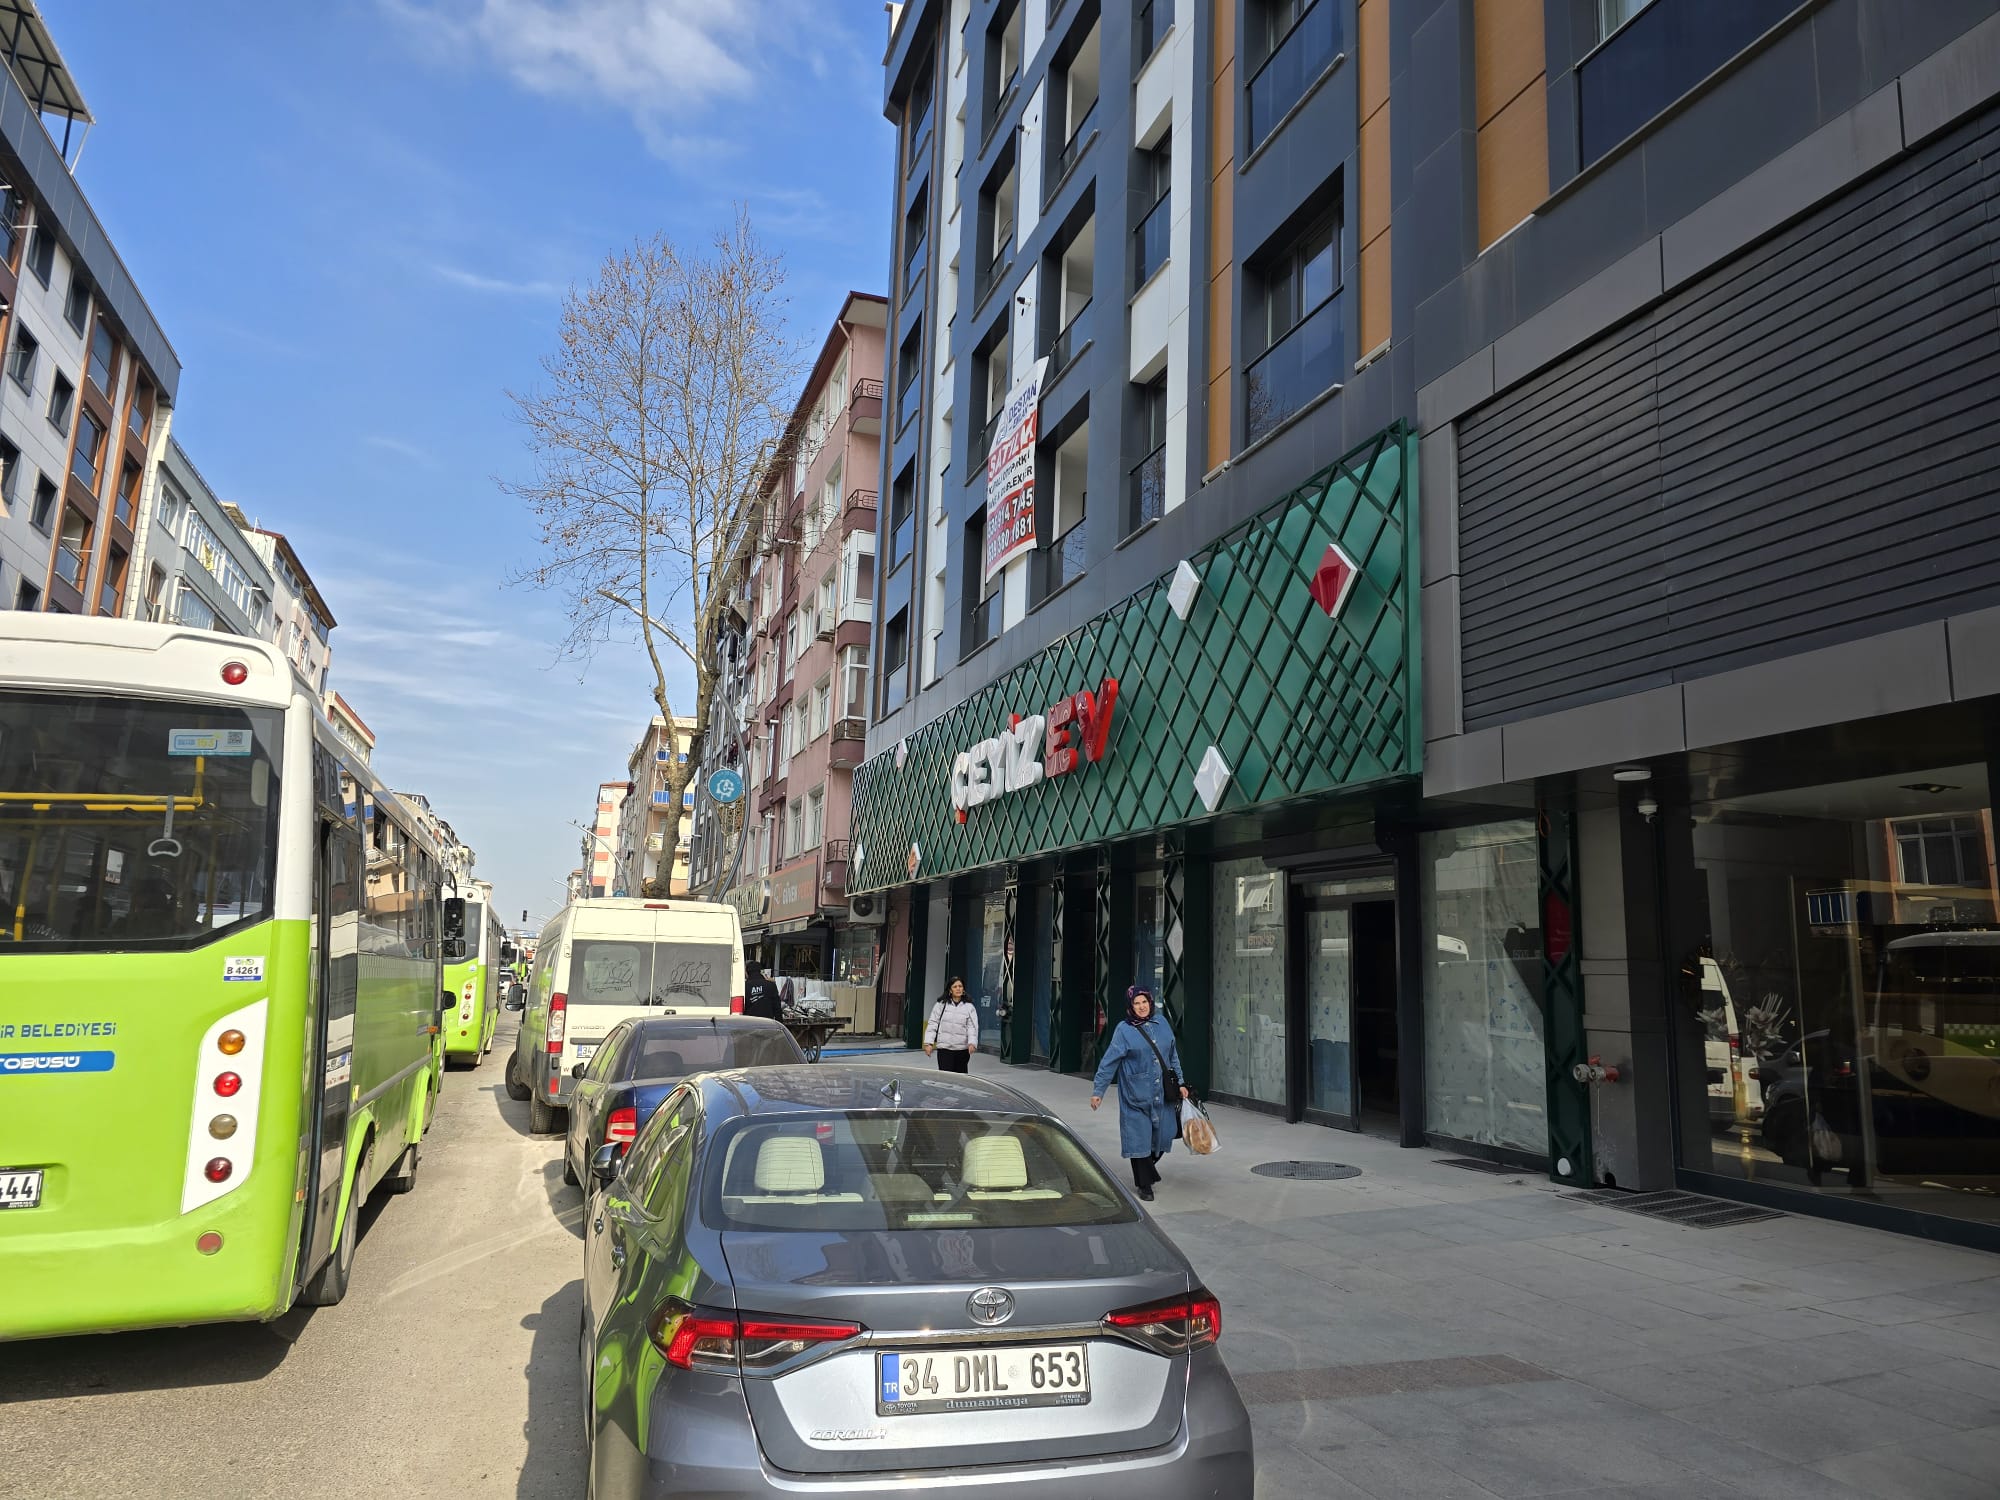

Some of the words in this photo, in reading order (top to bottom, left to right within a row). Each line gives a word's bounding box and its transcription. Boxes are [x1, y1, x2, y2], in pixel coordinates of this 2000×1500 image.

[1008, 379, 1037, 422] DESTAN
[226, 966, 234, 975] B
[235, 966, 259, 975] 4261
[0, 1176, 33, 1199] 44
[884, 1382, 898, 1394] TR
[903, 1358, 939, 1396] 34
[954, 1354, 1009, 1393] DML
[1030, 1351, 1081, 1389] 653
[946, 1397, 1029, 1409] dumankaya
